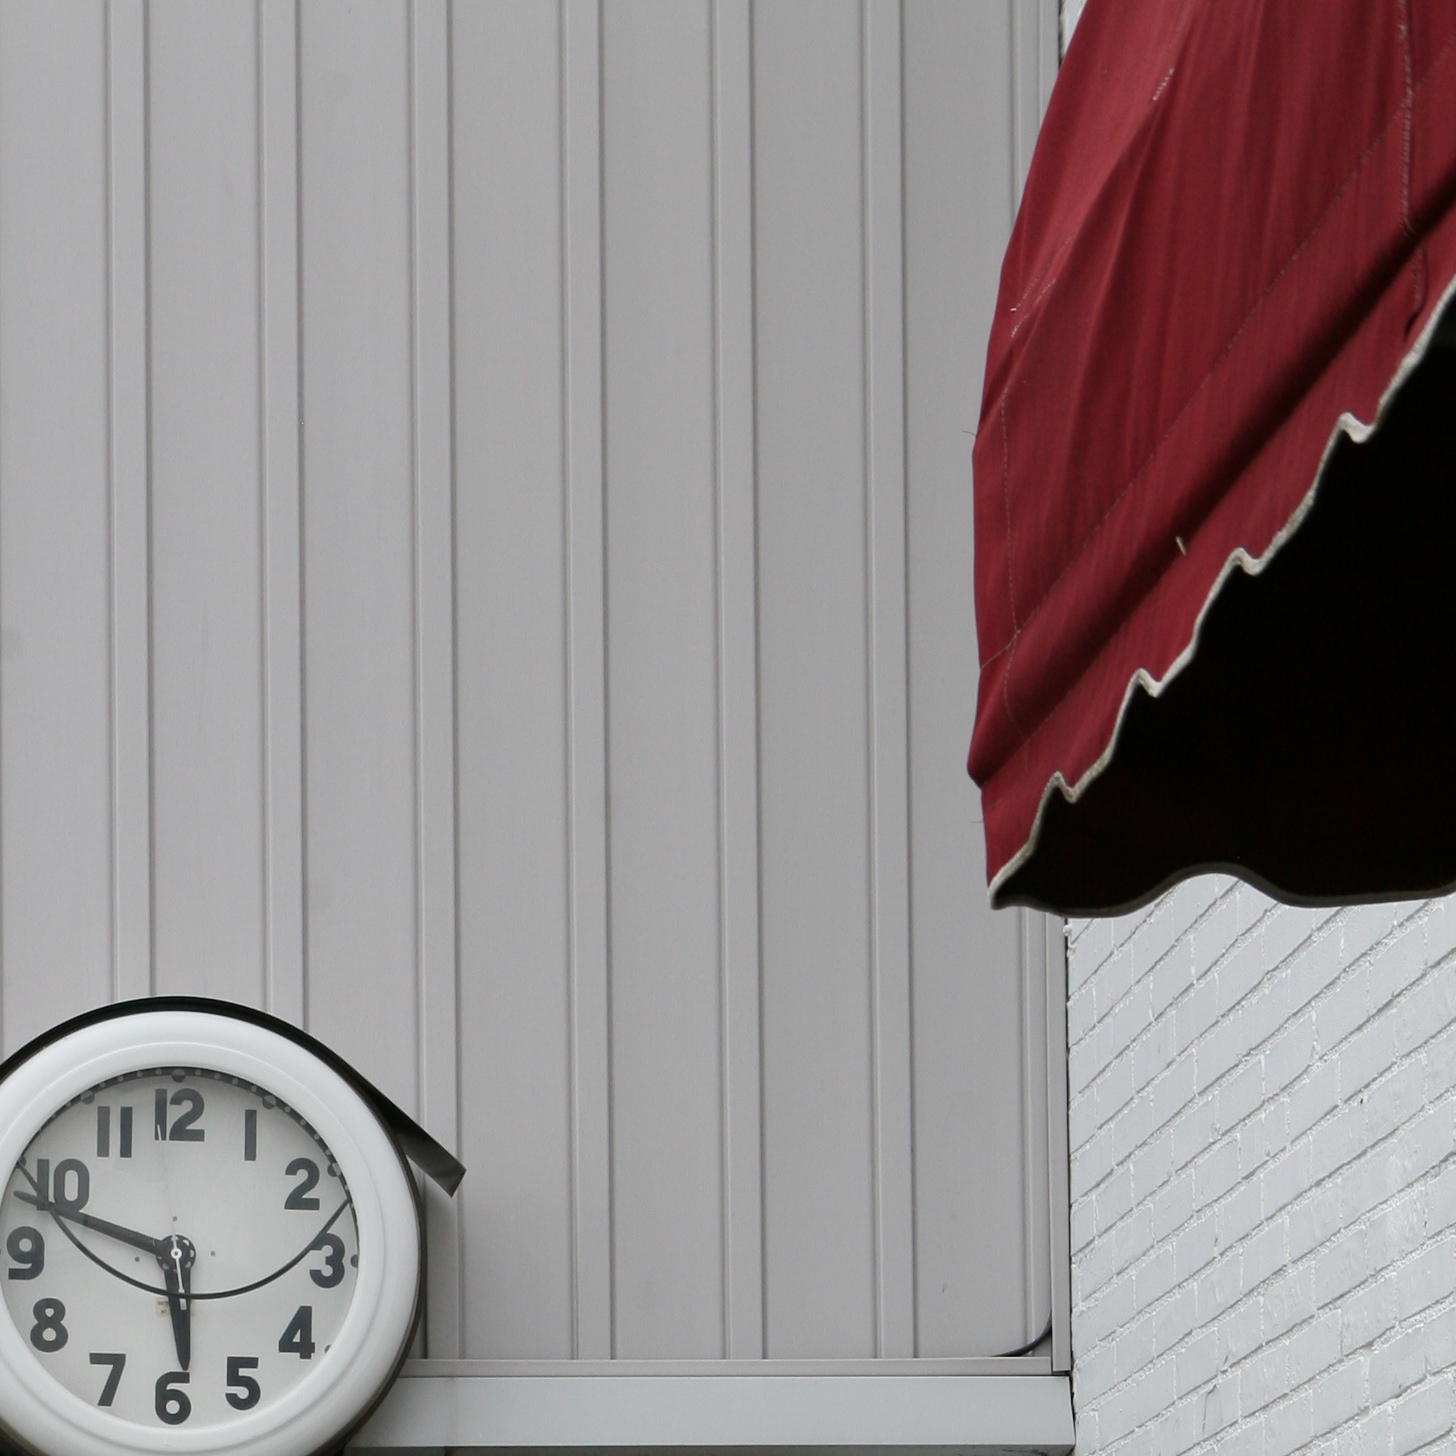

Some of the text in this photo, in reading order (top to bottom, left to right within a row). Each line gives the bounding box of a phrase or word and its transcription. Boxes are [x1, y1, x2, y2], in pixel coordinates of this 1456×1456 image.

[96, 1106, 133, 1158] 11
[155, 1088, 205, 1142] 12
[244, 1109, 257, 1161] 1
[36, 1158, 91, 1211] 10
[284, 1157, 320, 1210] 2
[6, 1226, 45, 1280] 9
[309, 1232, 345, 1288] 3
[30, 1297, 69, 1353] 8
[278, 1305, 316, 1359] 4
[89, 1352, 126, 1407] 7
[155, 1371, 191, 1425] 6
[225, 1356, 261, 1411] 5
